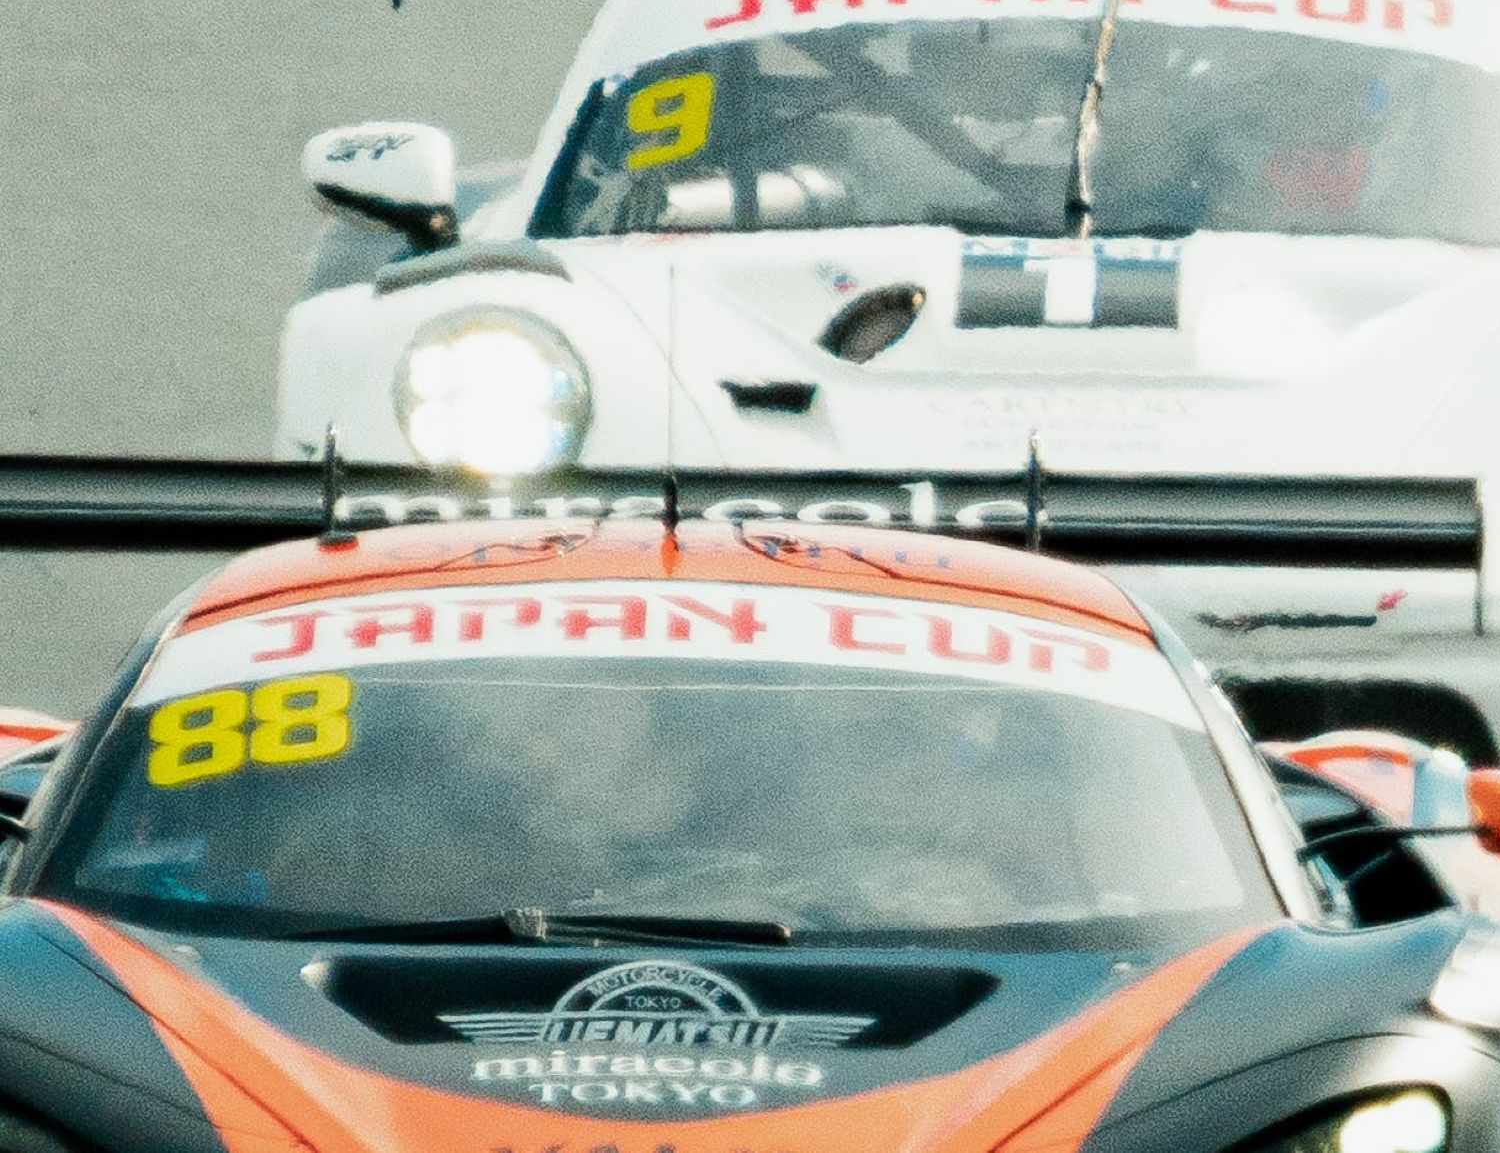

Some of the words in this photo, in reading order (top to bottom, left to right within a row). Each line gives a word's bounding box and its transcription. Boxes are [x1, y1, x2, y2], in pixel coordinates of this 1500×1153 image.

[627, 72, 715, 171] 9
[250, 596, 768, 665] JAPAN
[819, 602, 1111, 674] CUP
[147, 672, 355, 789] 88
[587, 966, 726, 1005] MOTORCYCLE
[624, 994, 683, 1009] TOKYO
[472, 1050, 825, 1088] miracolo
[529, 1081, 757, 1106] TOKYO
